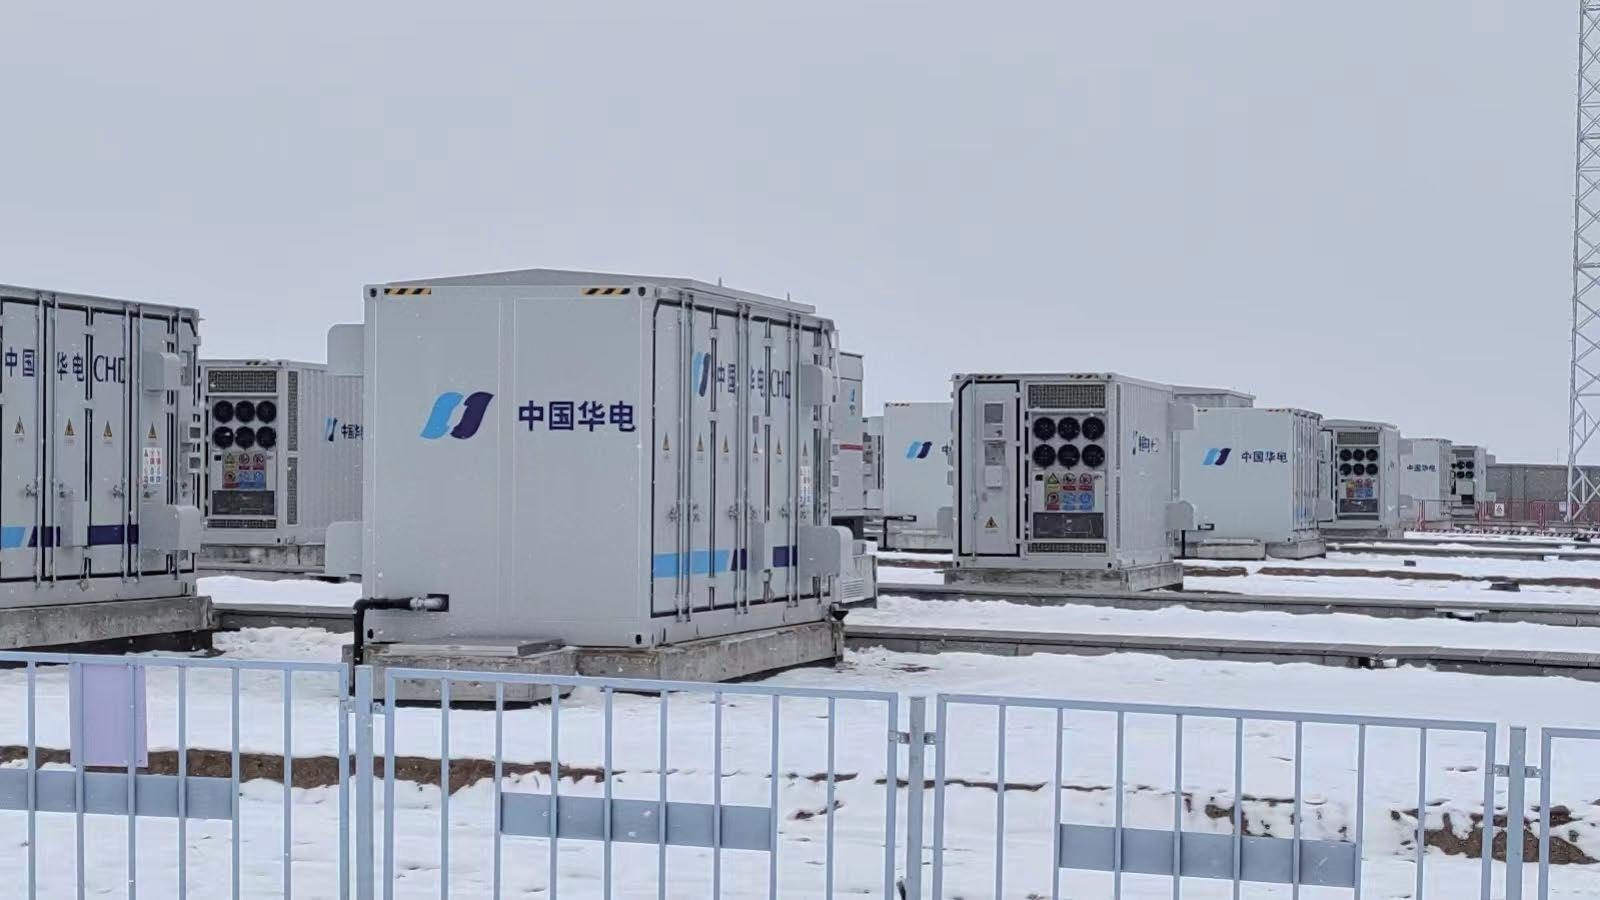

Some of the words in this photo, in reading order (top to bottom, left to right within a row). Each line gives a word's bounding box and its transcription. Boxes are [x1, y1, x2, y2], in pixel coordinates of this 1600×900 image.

[519, 400, 636, 432] 中国华电
[1241, 451, 1288, 464] 中国华电
